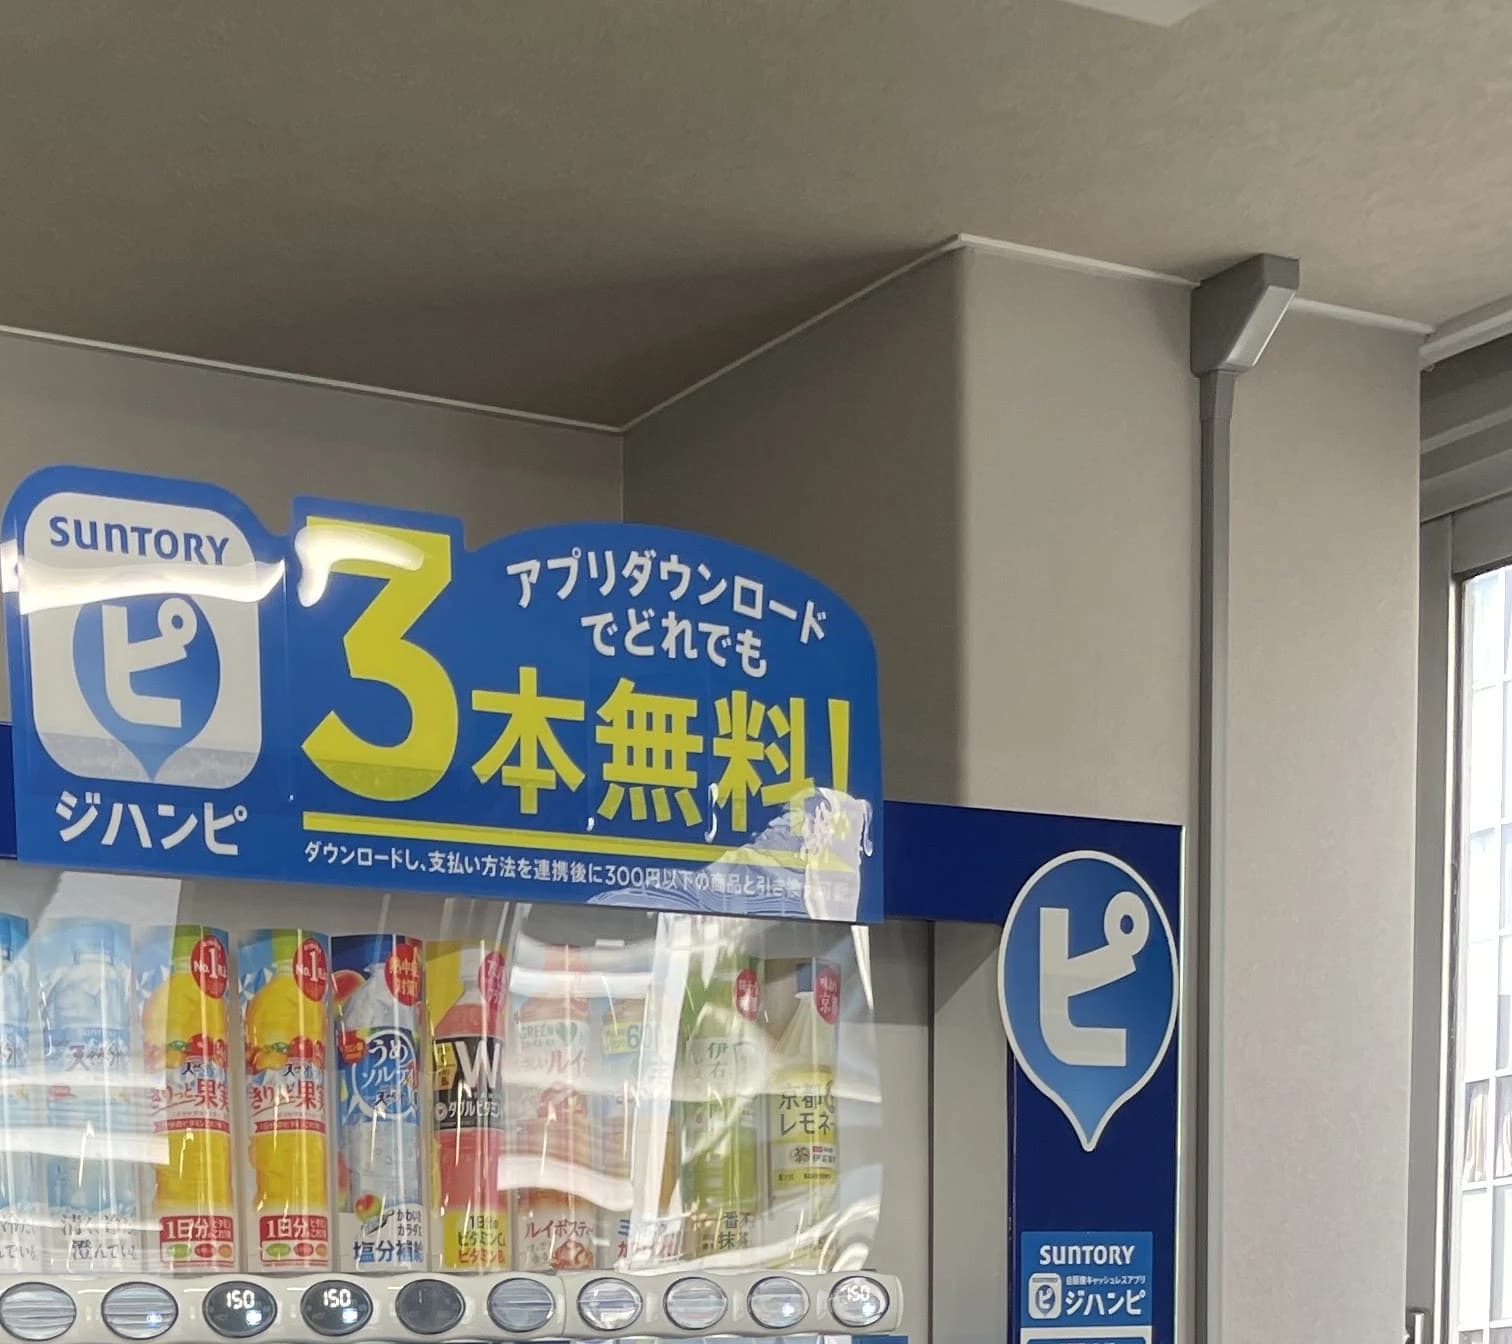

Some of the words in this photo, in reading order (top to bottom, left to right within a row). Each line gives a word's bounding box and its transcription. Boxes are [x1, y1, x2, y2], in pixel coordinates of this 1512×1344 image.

[47, 514, 231, 566] SUNTORY
[507, 547, 825, 644] アプリダウンロード
[102, 595, 197, 729] ピ
[582, 611, 768, 676] でどれでも
[53, 789, 249, 856] ジハンピ
[1039, 891, 1150, 1067] ピ
[266, 1218, 309, 1240] 1日分
[1040, 1245, 1135, 1265] SUNTORY
[226, 1290, 256, 1310] 150
[323, 1288, 352, 1308] 150
[1065, 1289, 1146, 1315] ジハンピ
